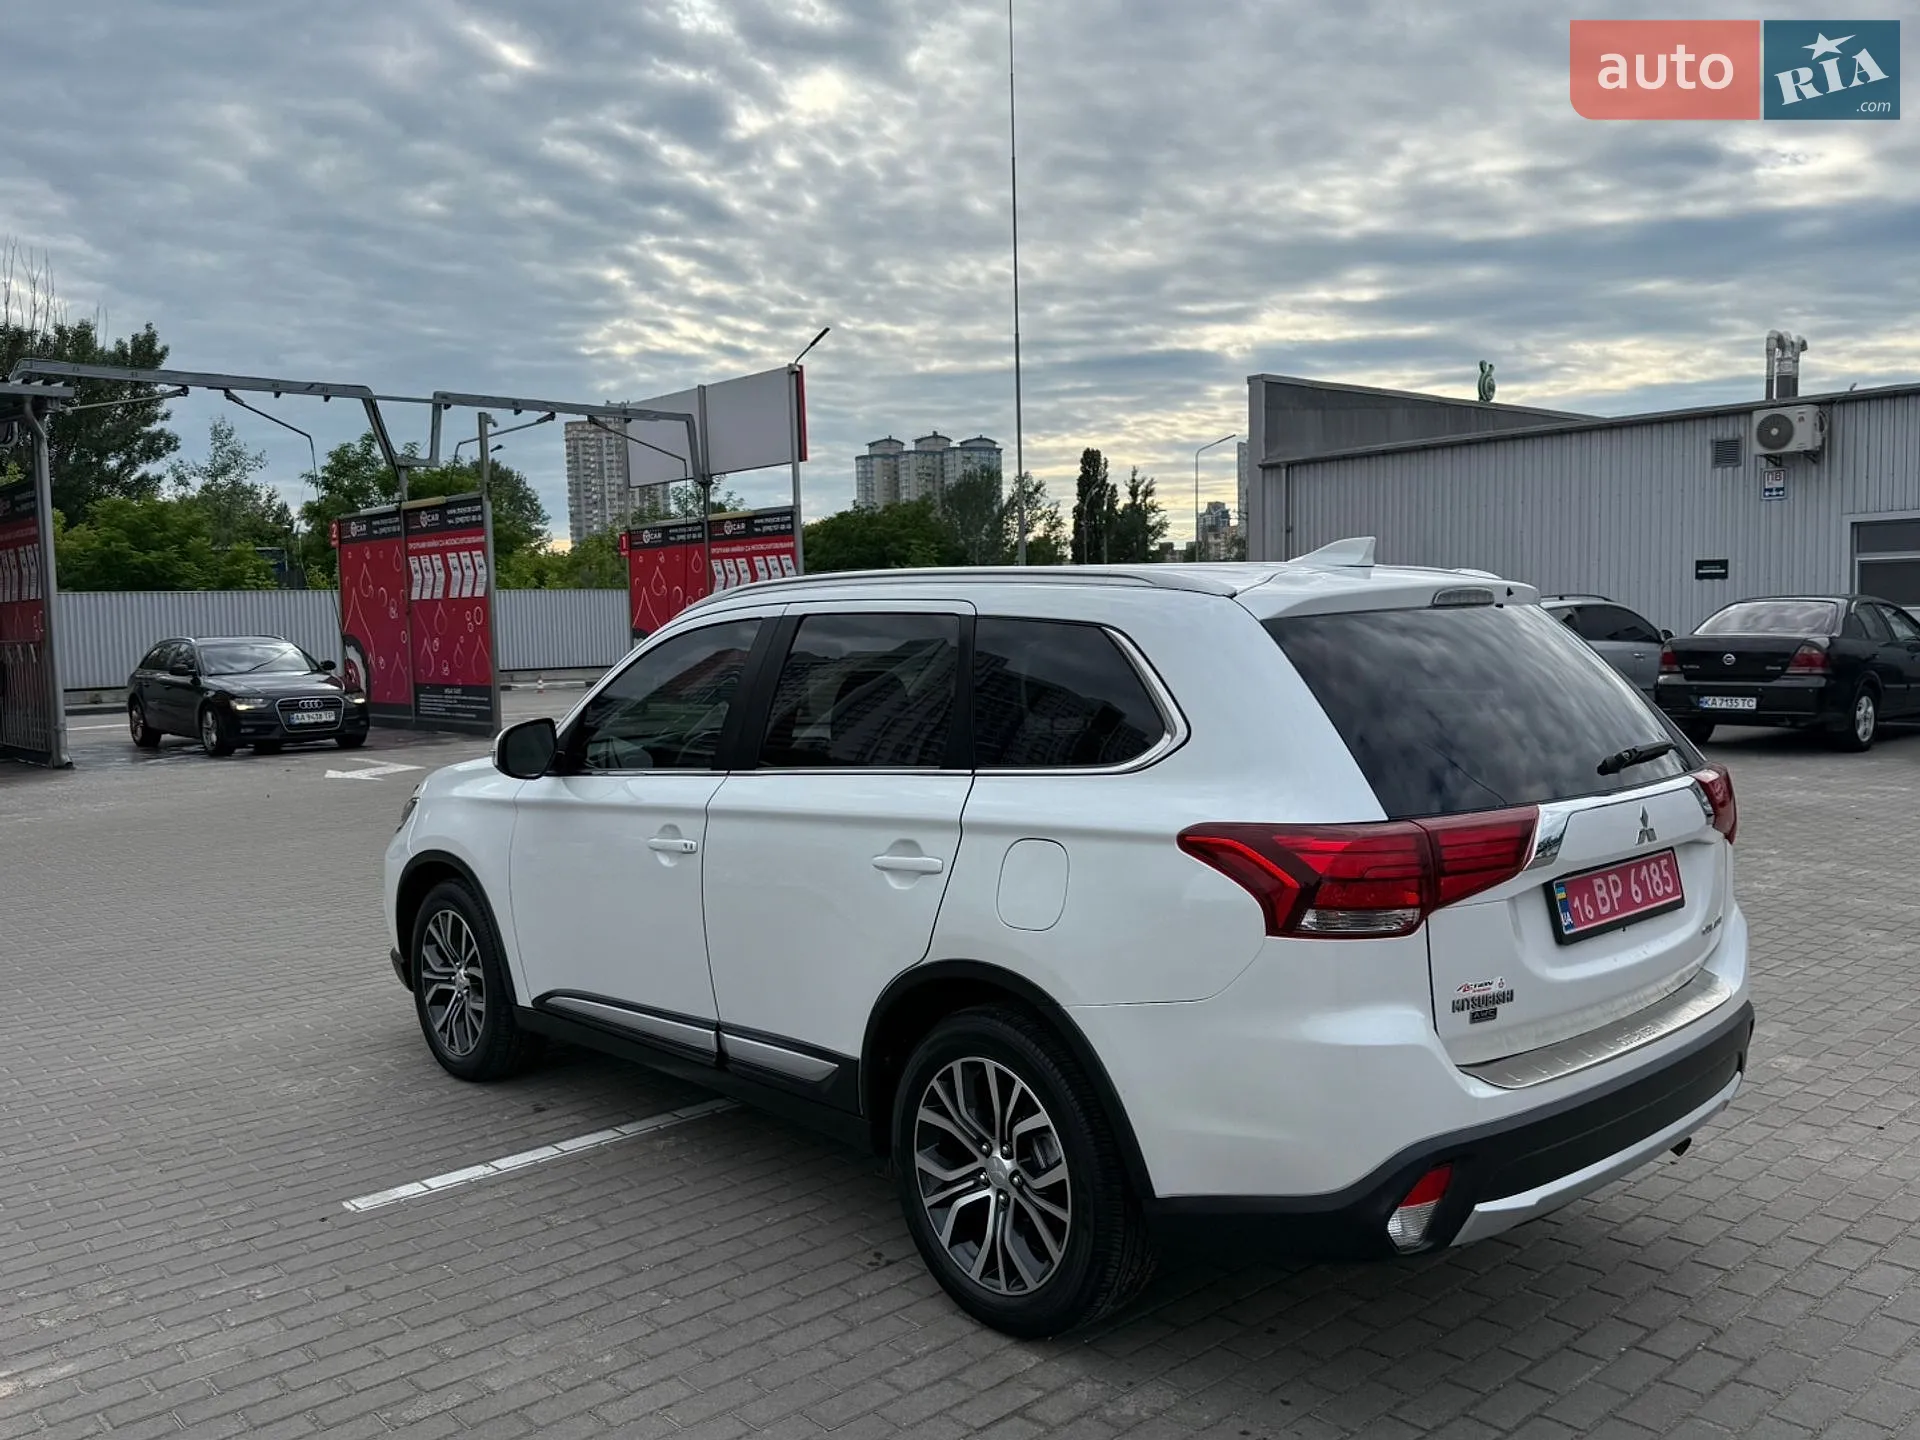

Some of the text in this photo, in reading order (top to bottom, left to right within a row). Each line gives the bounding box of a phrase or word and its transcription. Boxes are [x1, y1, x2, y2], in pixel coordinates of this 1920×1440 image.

[1560, 858, 1674, 926] UA 16 BP 6185
[1451, 988, 1514, 1014] MITSUBISHI
